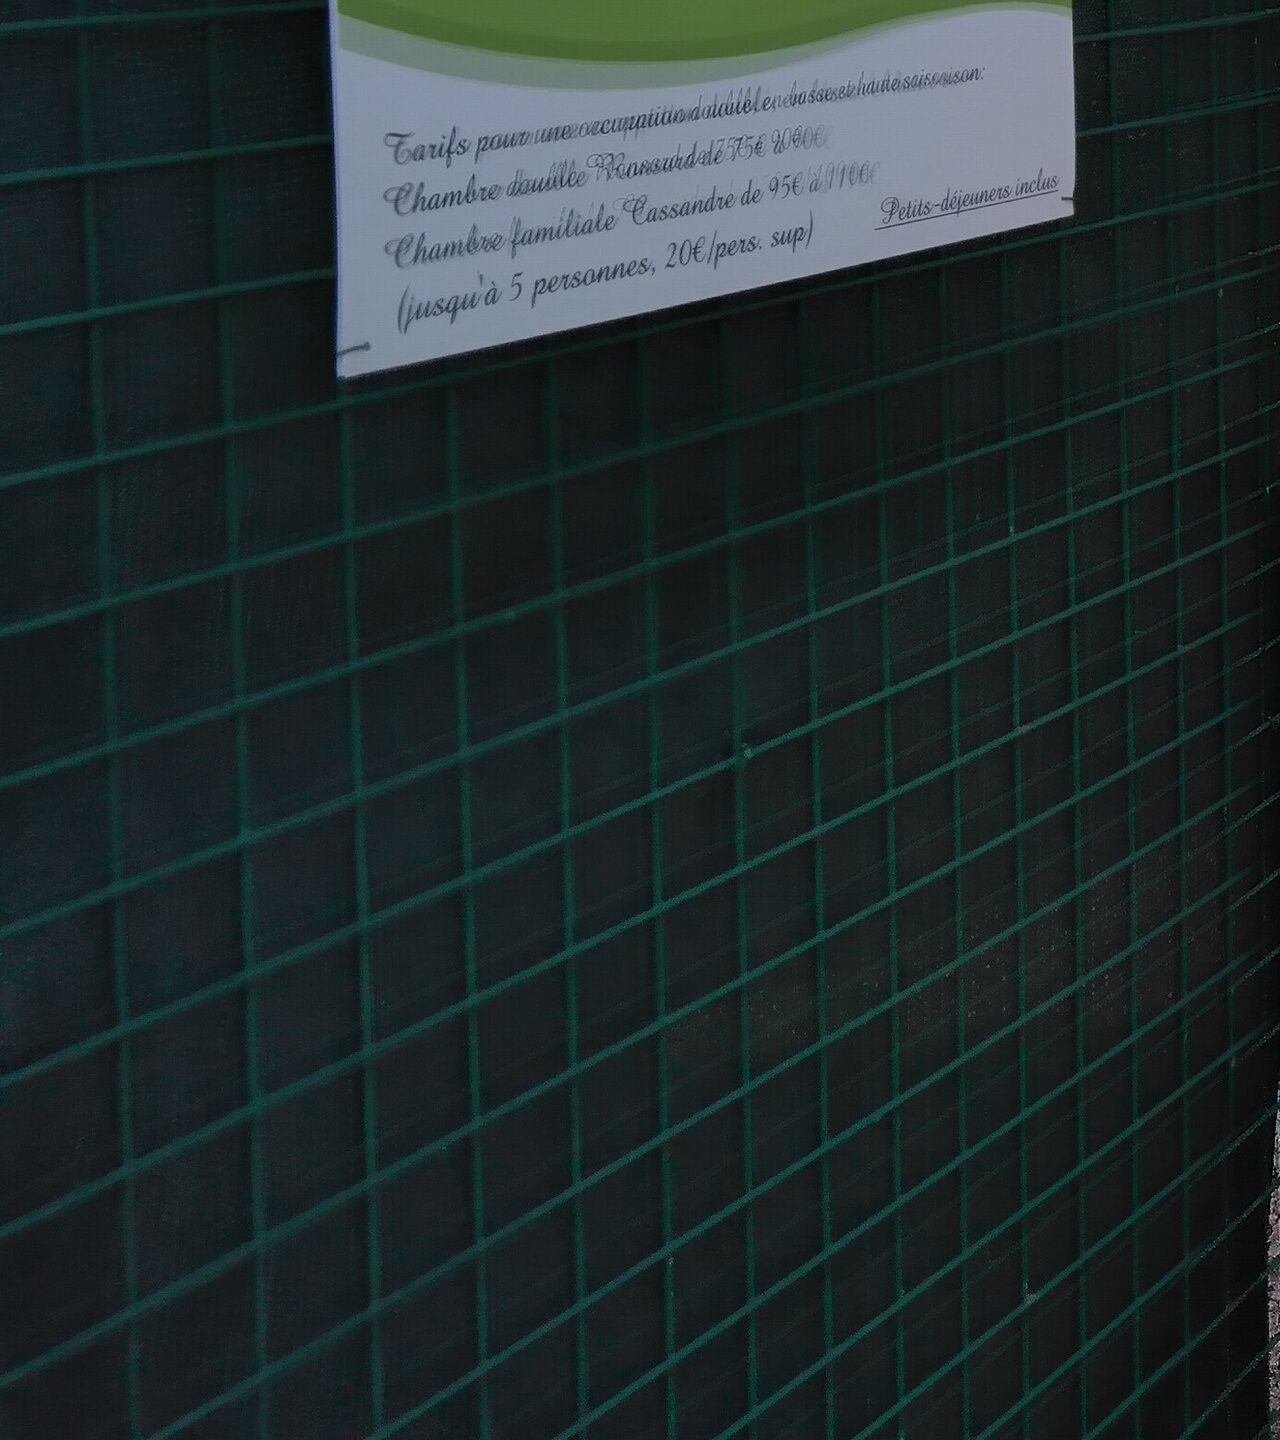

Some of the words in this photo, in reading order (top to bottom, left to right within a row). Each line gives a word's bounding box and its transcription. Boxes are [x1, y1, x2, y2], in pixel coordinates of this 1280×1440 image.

[384, 124, 470, 168] Tarifs
[473, 128, 530, 164] pour
[384, 173, 503, 216] Chambre
[384, 223, 504, 269] Chambre
[507, 203, 618, 260] familiale
[616, 184, 737, 226] Cassandre
[740, 178, 765, 207] de
[768, 173, 804, 201] 95€
[880, 188, 1013, 226] Petits-déjeuners
[1014, 168, 1060, 196] inclus
[510, 272, 523, 302] 5
[531, 256, 657, 309] personnes,
[771, 210, 815, 254] sup)
